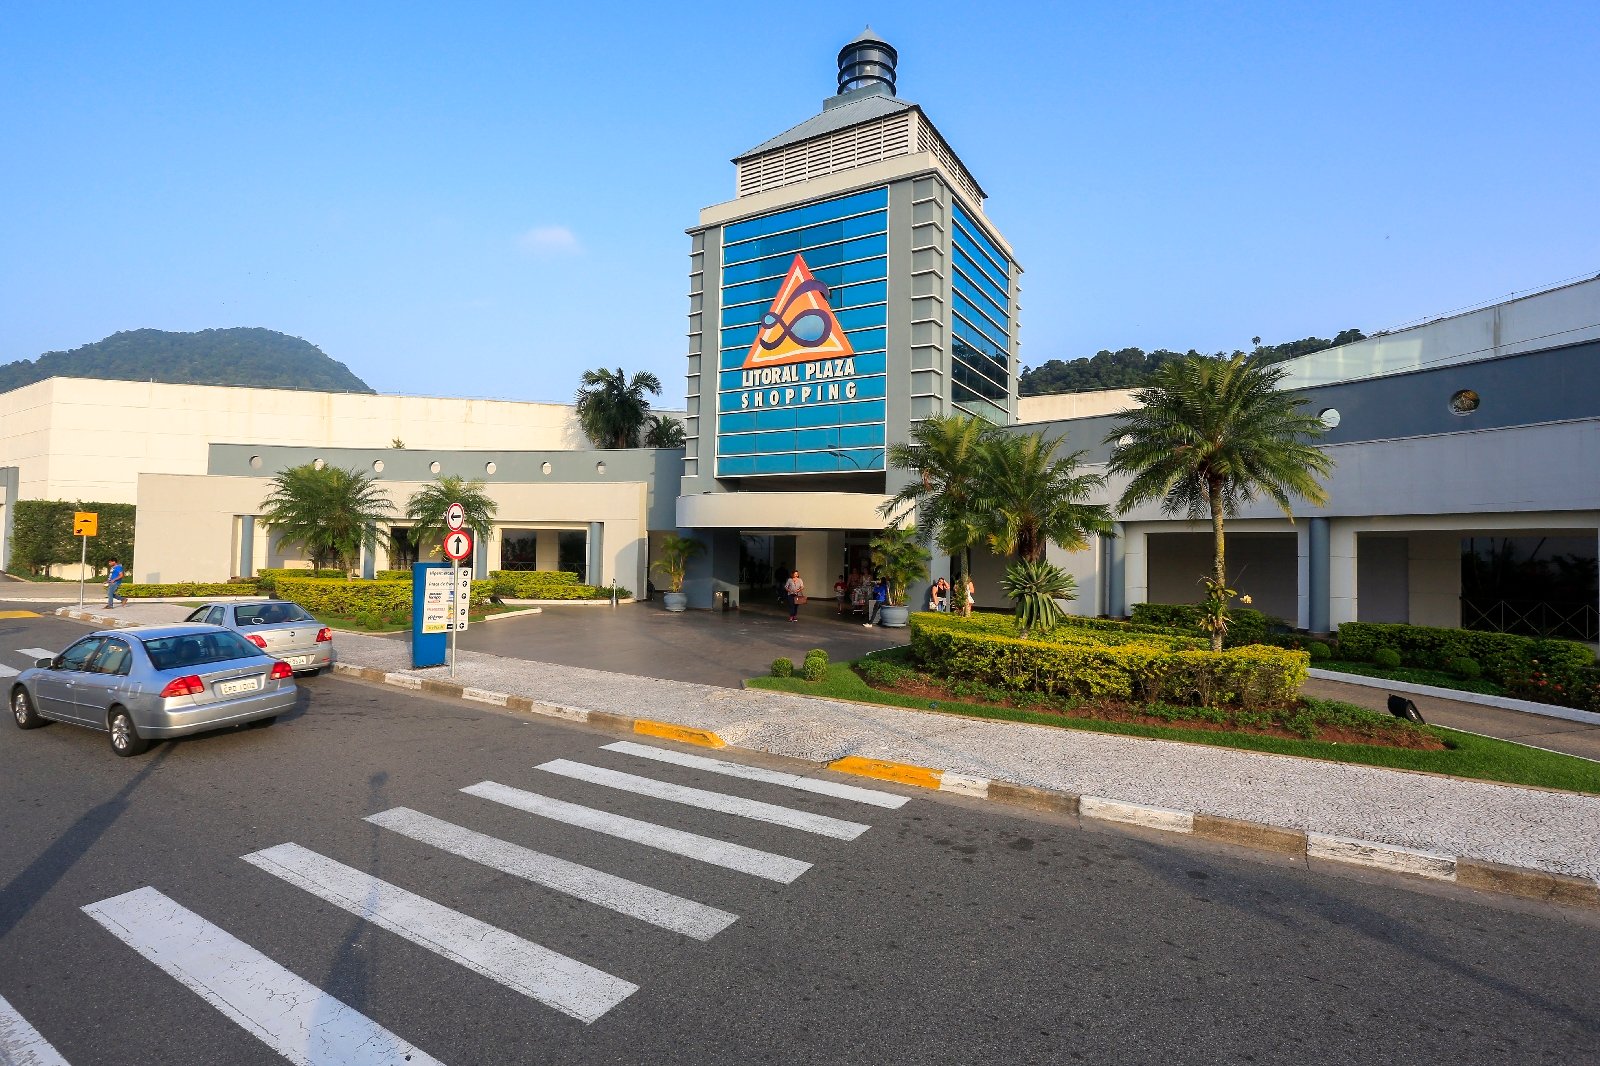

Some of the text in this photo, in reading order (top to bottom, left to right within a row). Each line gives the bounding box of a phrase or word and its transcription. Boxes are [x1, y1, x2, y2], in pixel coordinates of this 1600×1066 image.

[742, 358, 855, 387] LITORAL PLAZA
[741, 382, 857, 409] SHOPPING
